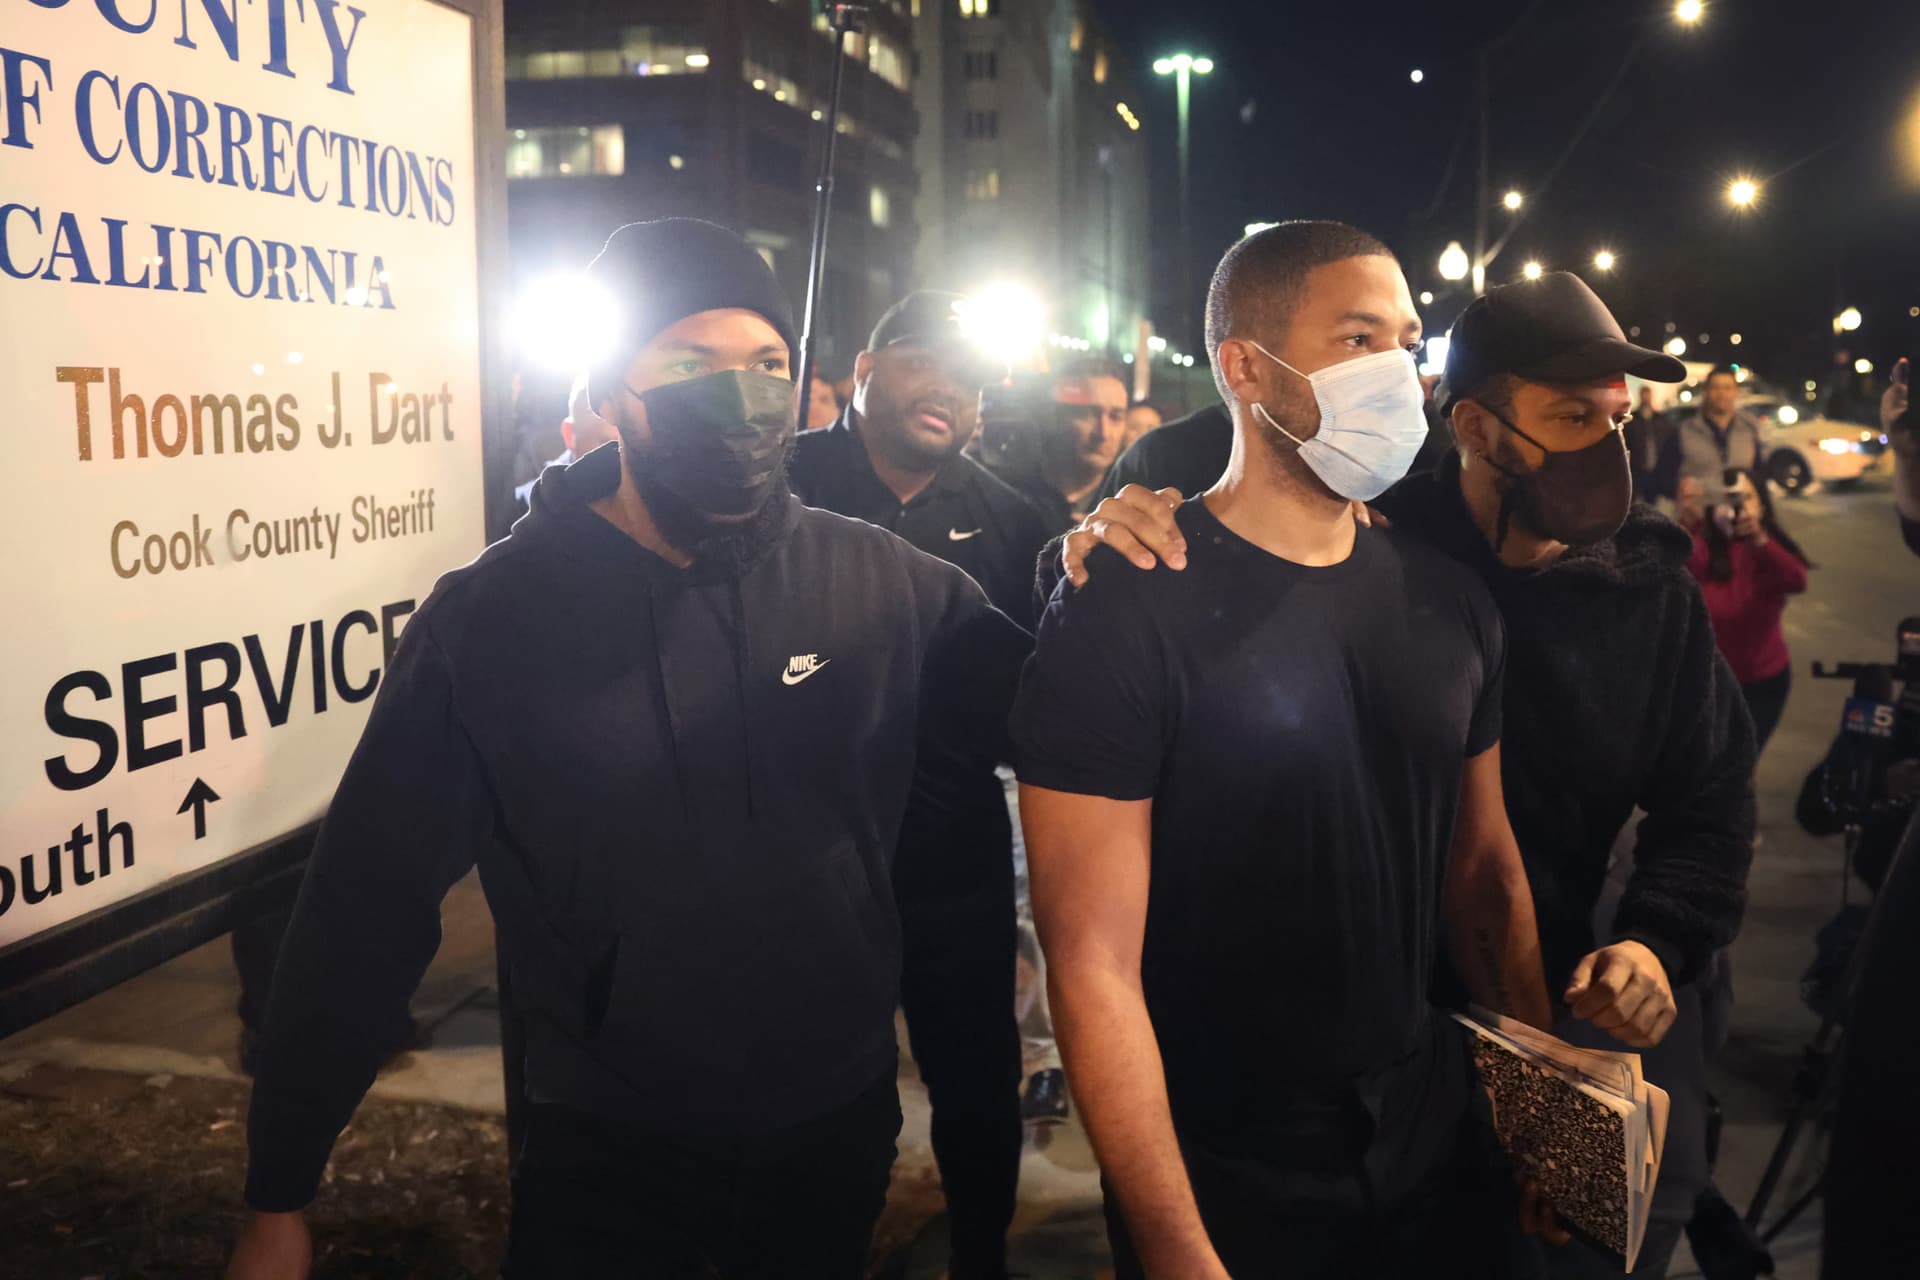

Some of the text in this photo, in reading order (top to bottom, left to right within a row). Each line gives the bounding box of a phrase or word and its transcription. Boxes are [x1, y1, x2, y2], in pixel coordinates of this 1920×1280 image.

[26, 0, 367, 96] NTY
[0, 47, 454, 226] F CORRECTIONS
[0, 203, 396, 310] CALIFORNIA
[56, 366, 454, 461] Thomas J. Dart
[110, 488, 435, 579] Cook County Sheriff
[789, 653, 818, 672] NIKE
[1873, 705, 1893, 728] 5
